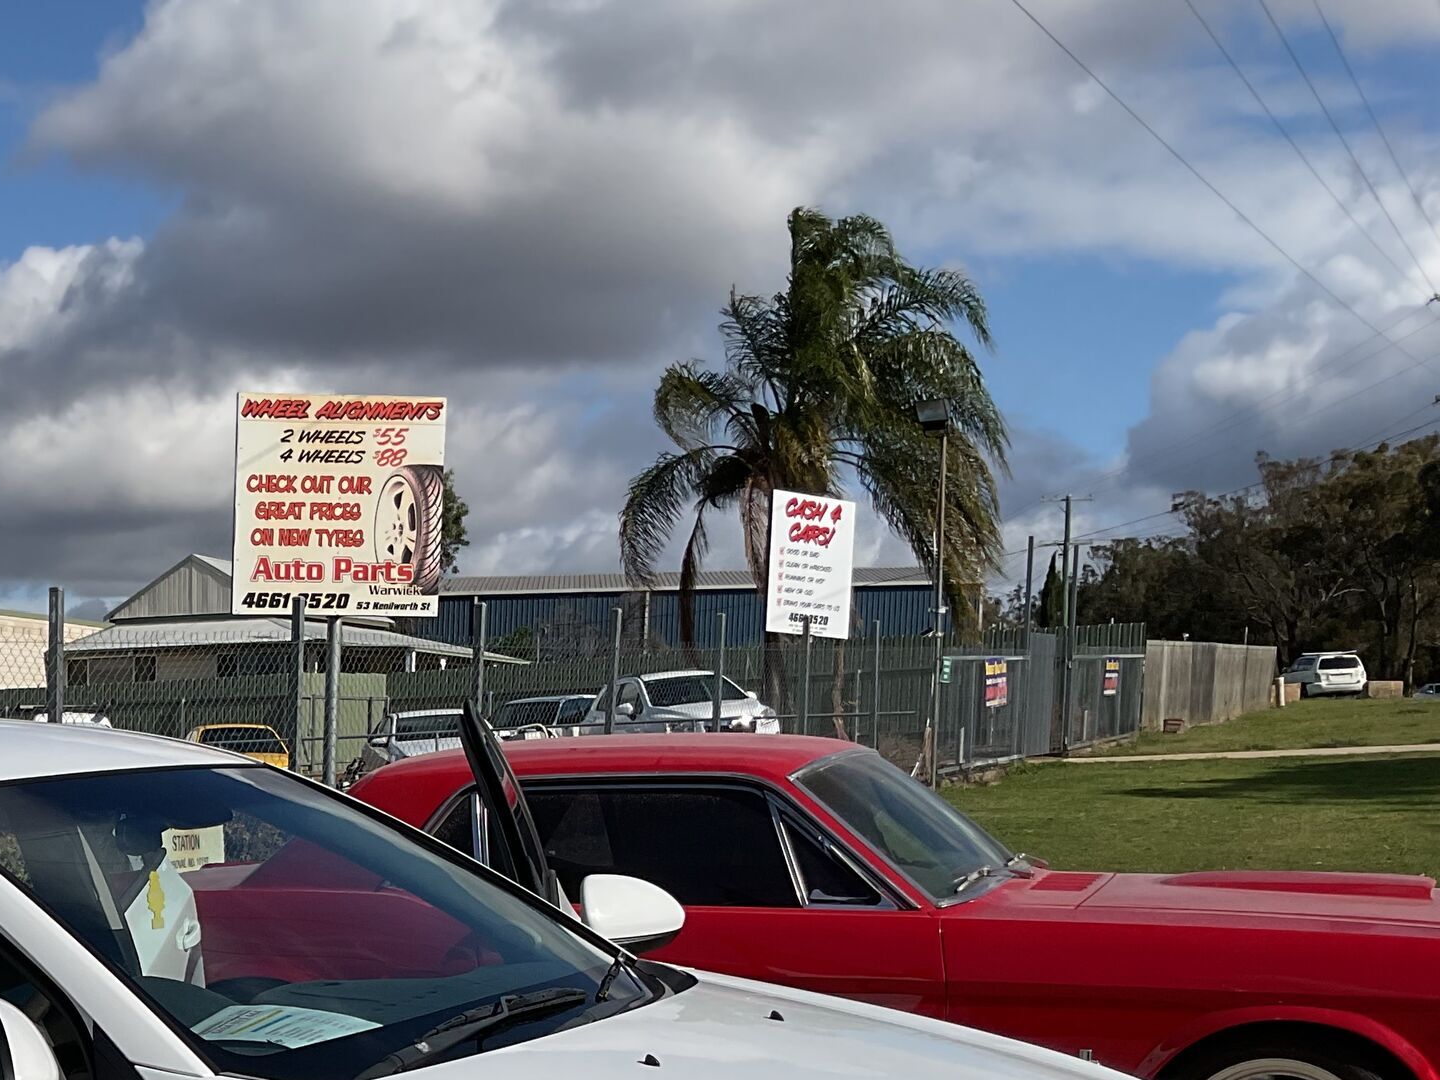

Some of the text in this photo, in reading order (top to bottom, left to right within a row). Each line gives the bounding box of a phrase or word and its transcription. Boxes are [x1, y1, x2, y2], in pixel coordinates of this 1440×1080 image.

[241, 399, 443, 421] WHEEL ALIGNMENTS
[280, 428, 409, 446] 2 WHEELS $55
[279, 449, 408, 467] 4 WHEELS $88
[246, 475, 372, 495] CHECK OUT OUR
[255, 502, 362, 521] GREAT PRICES
[786, 497, 843, 525] CASH 4
[250, 528, 365, 547] ON NEW TYRES
[788, 522, 836, 548] CARS!
[250, 556, 415, 584] Auto Parts
[369, 585, 422, 596] Warwick
[242, 592, 292, 609] 4661
[356, 601, 430, 611] 53 Kenilworth St
[172, 834, 200, 851] STATION
